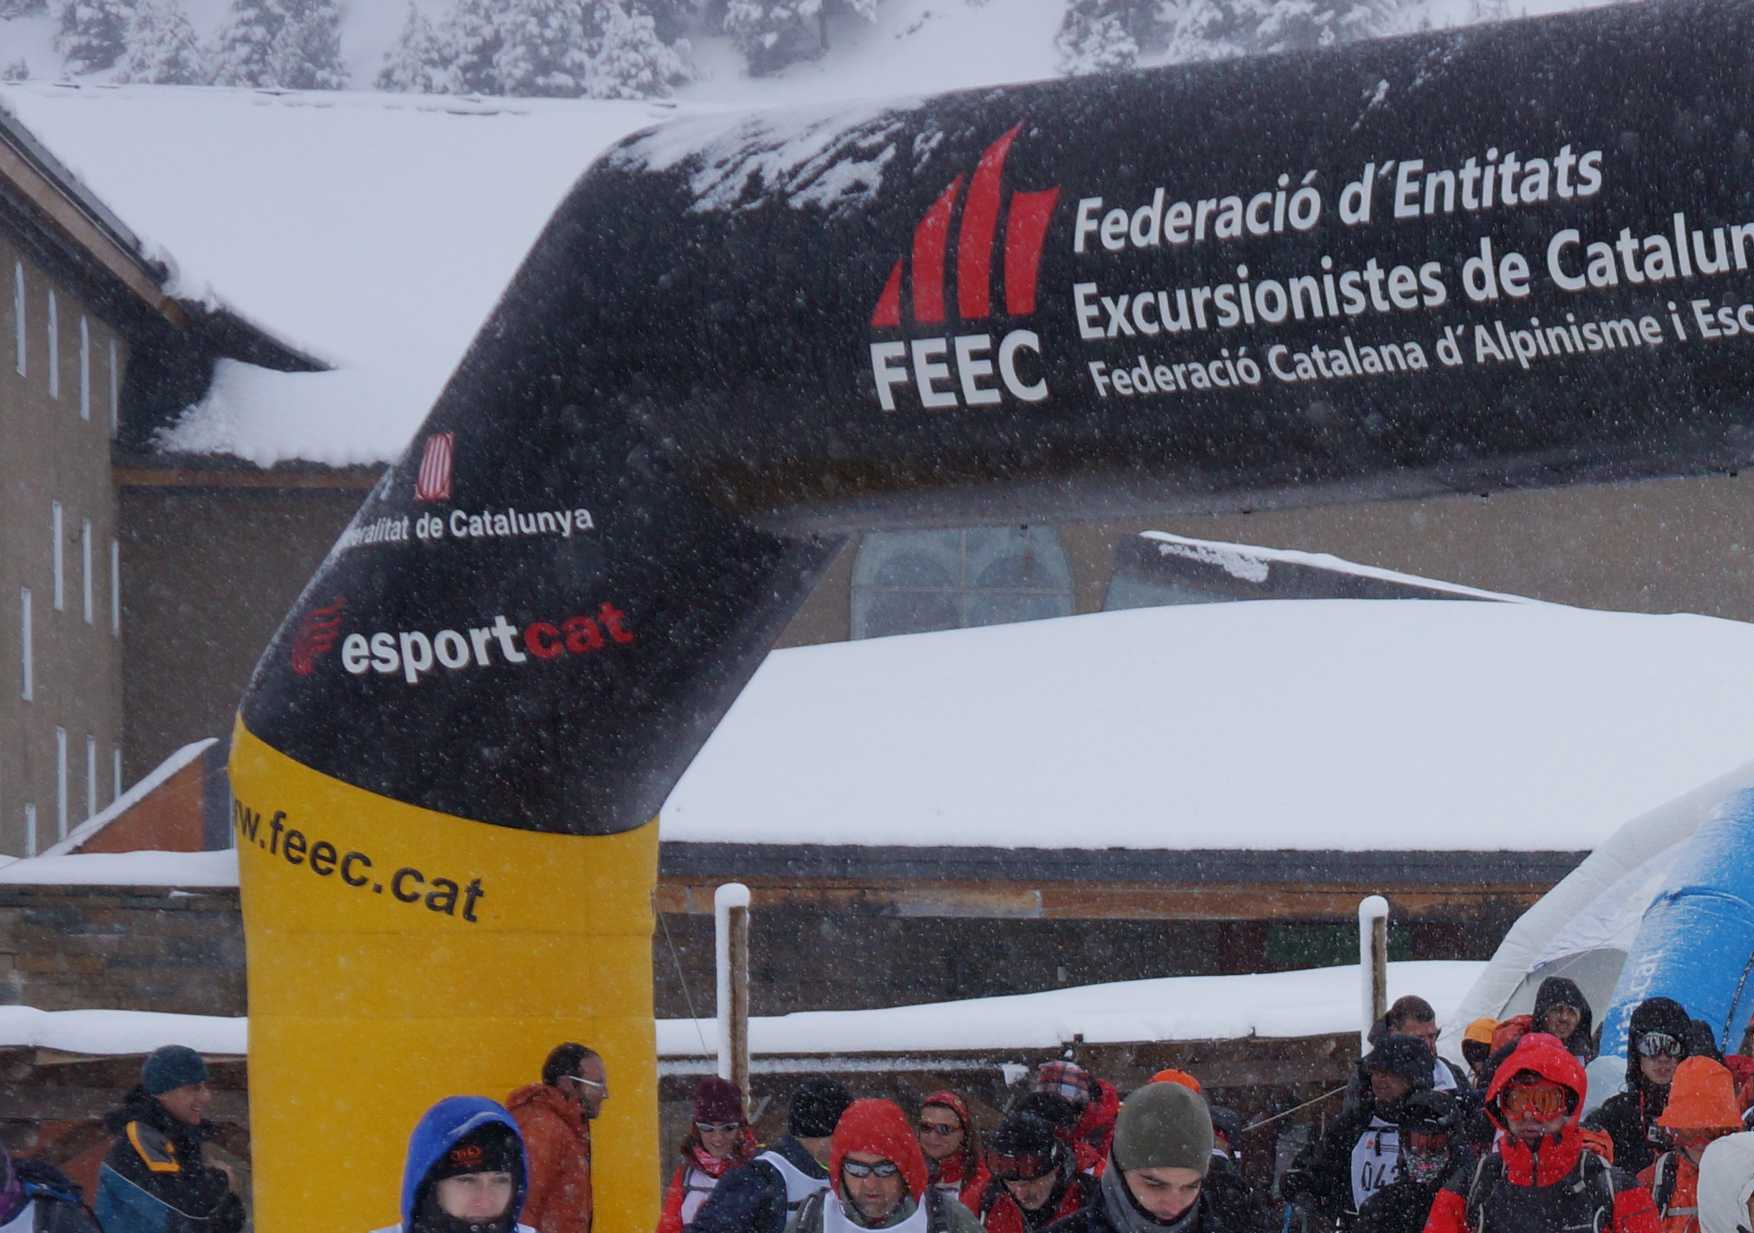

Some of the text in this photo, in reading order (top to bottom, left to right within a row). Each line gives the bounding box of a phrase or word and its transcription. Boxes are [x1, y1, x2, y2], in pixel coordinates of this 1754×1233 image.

[1073, 170, 1321, 253] Federació
[1073, 255, 1447, 339] Excursionistes
[1462, 236, 1531, 302] de
[869, 329, 1049, 411] FEEC
[1088, 345, 1261, 397] Federació
[1267, 335, 1428, 382] Catalana
[1667, 301, 1687, 341] i
[415, 512, 444, 540] de
[450, 507, 594, 538] Catalunya
